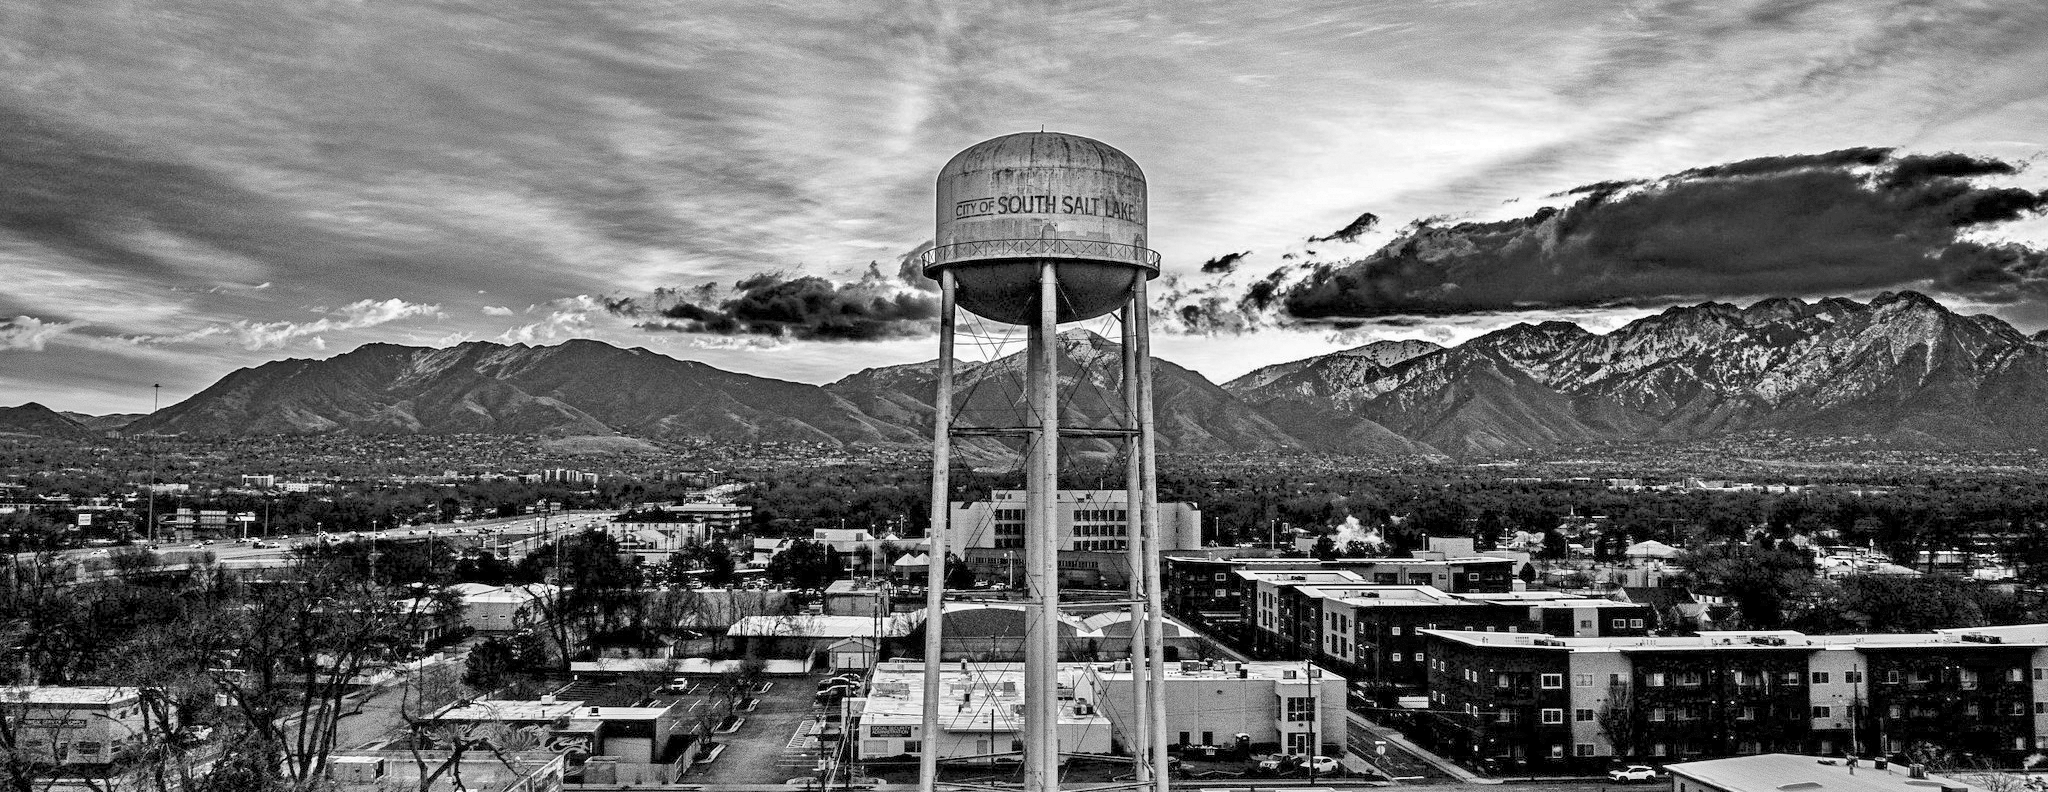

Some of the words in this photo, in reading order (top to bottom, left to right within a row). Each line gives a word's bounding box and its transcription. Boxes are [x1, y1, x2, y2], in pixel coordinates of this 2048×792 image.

[956, 202, 977, 217] CITY
[979, 200, 995, 213] OF
[998, 195, 1056, 215] SOUTH
[1062, 195, 1100, 216] SALT
[1105, 198, 1135, 221] LAKE
